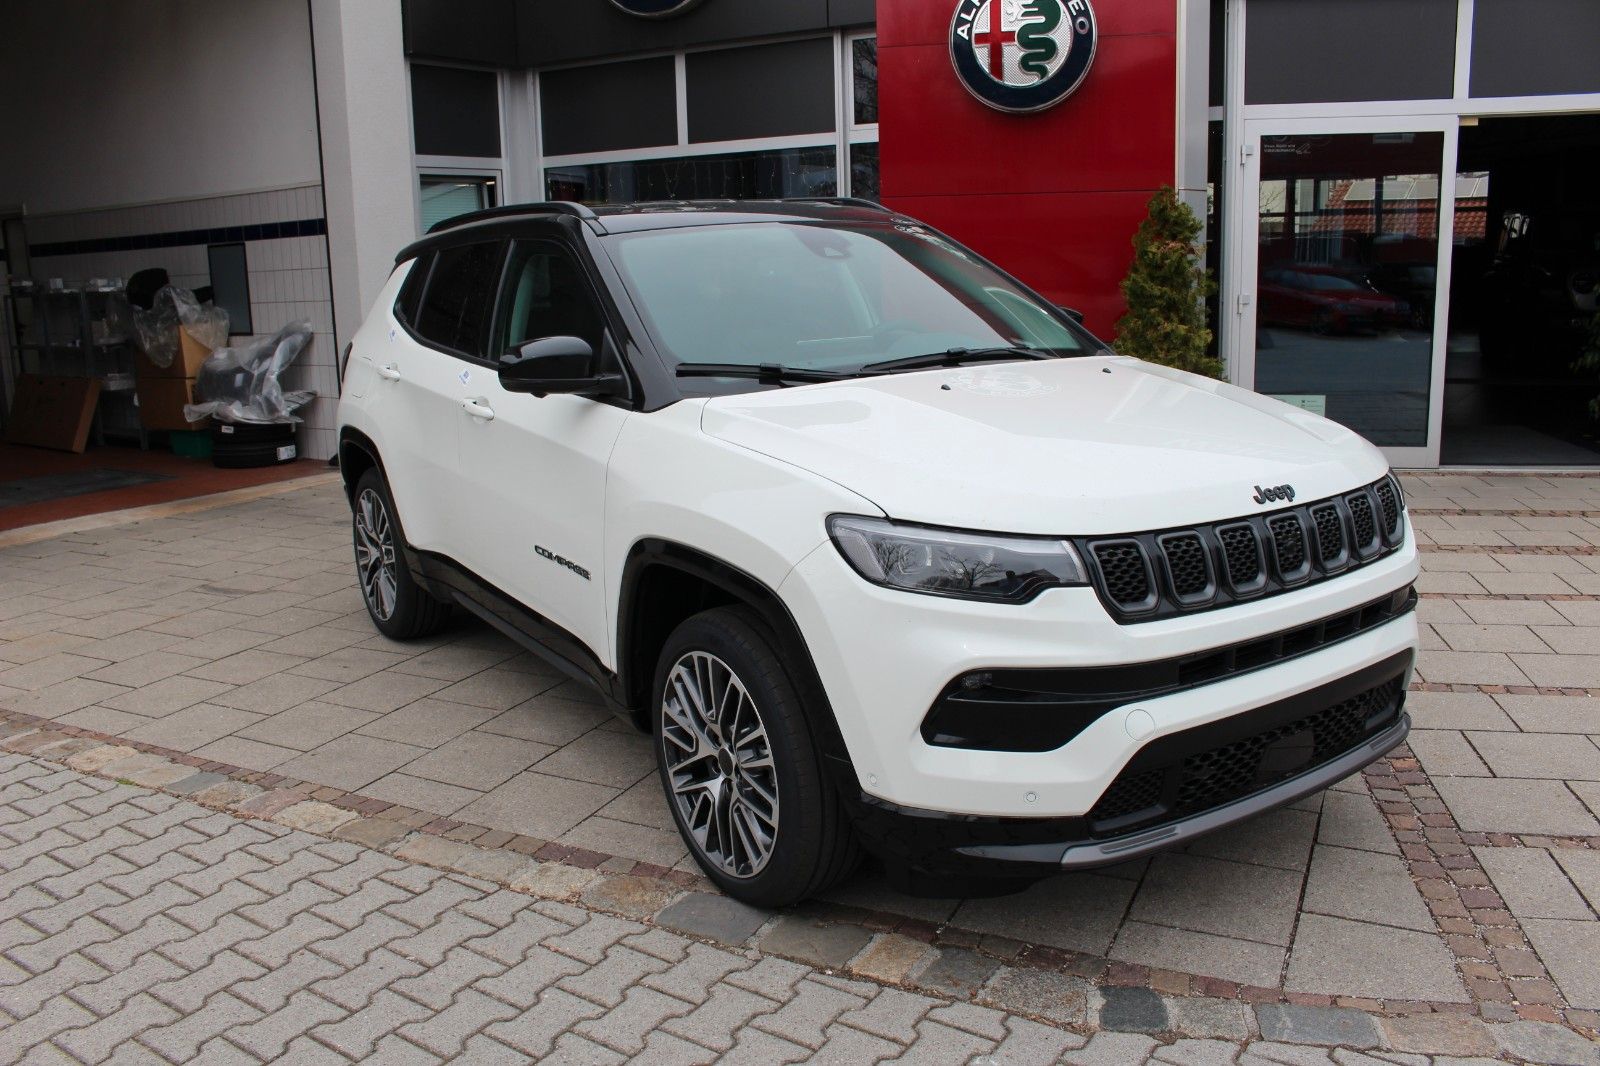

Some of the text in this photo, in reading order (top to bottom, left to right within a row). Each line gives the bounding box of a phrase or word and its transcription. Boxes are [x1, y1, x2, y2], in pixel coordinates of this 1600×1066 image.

[956, 0, 1090, 41] AL EO
[1252, 484, 1296, 505] Jeep
[534, 544, 592, 581] COMPASS
